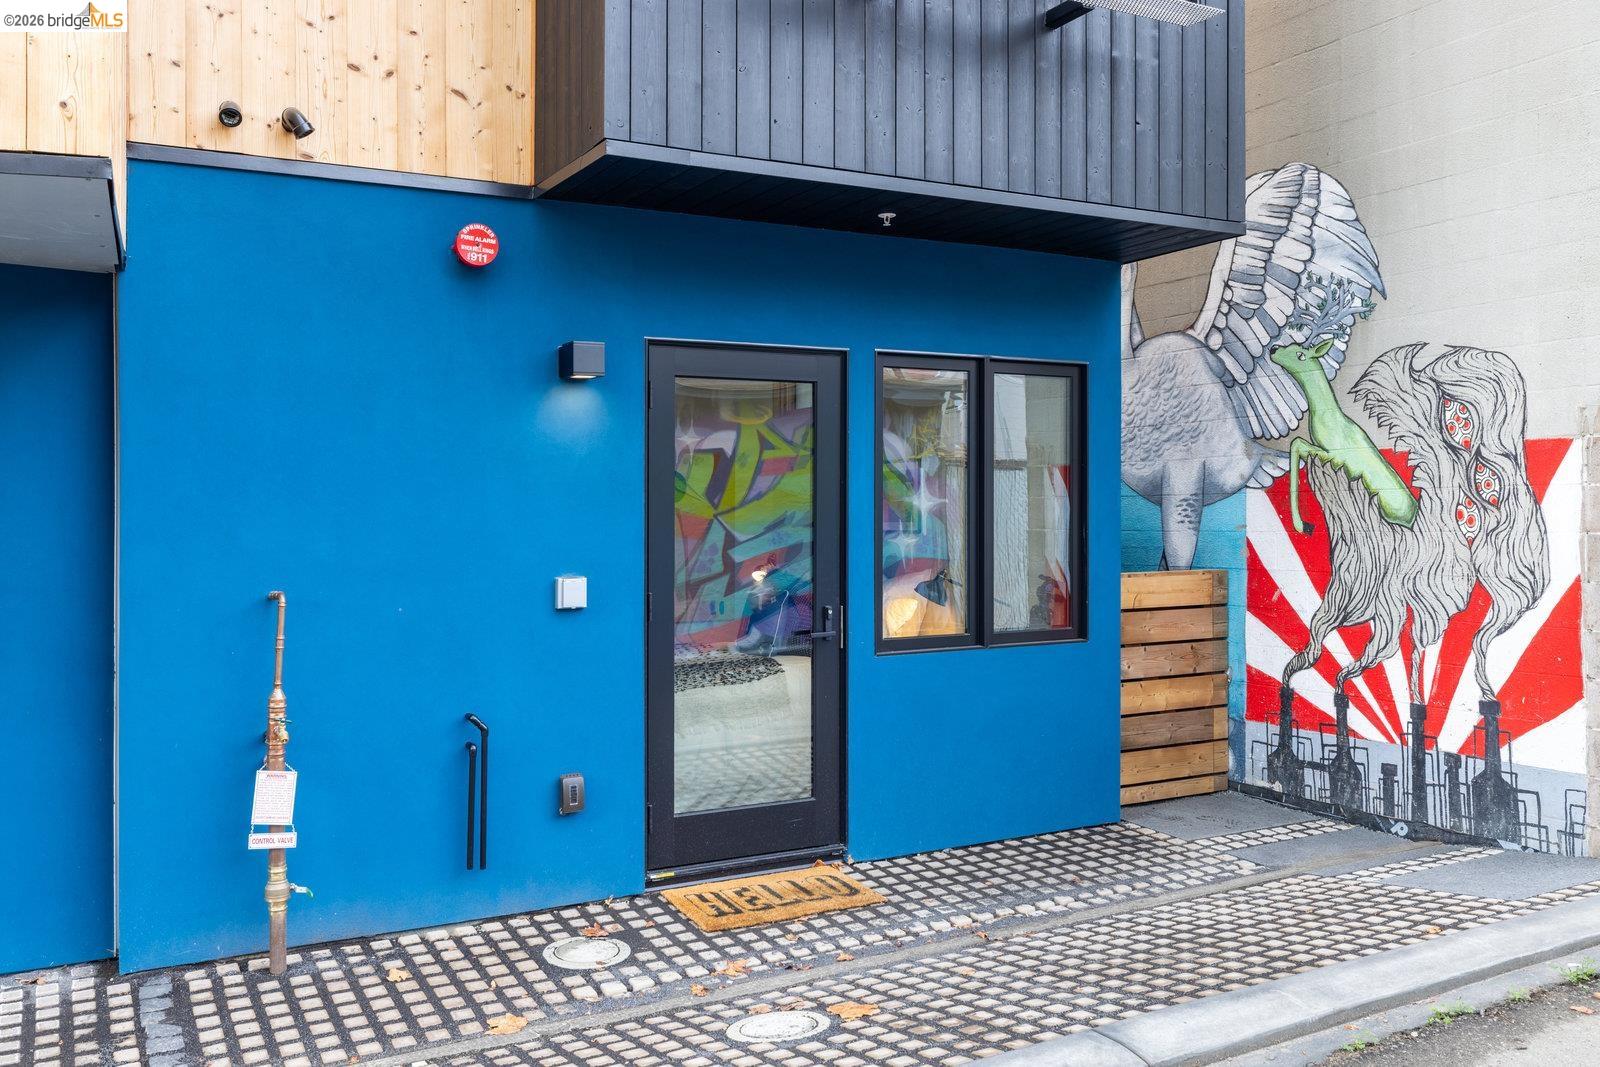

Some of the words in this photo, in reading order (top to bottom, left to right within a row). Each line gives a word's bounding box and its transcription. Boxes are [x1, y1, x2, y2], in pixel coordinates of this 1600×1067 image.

[463, 224, 495, 239] SPRINKLER
[471, 252, 488, 263] 911
[277, 836, 294, 844] VALVE
[684, 874, 860, 918] HELLO
